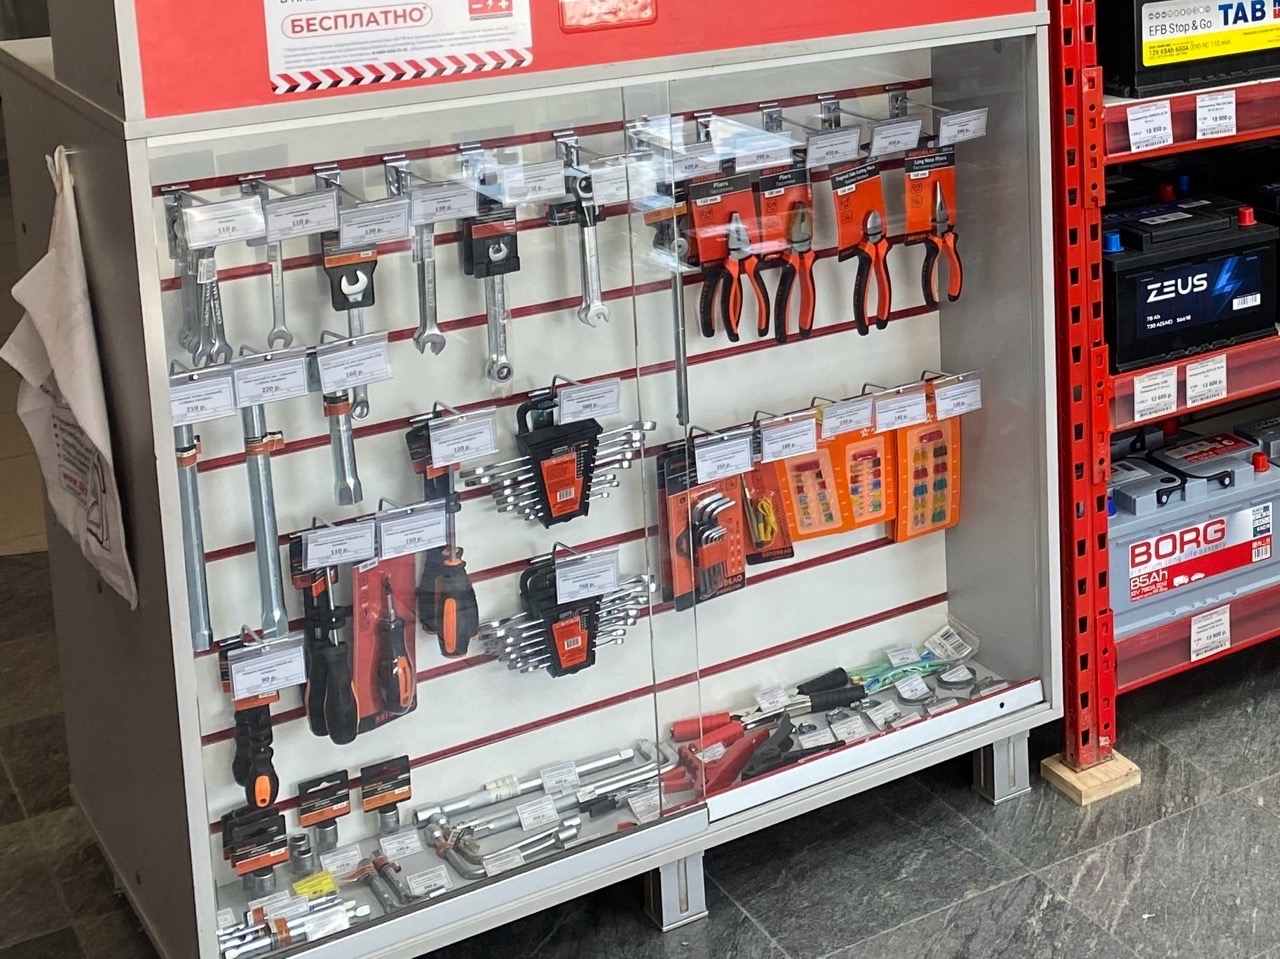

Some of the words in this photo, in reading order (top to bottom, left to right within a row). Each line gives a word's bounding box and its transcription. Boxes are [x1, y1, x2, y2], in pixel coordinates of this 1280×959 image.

[290, 6, 424, 34] БЕСПЛАТНО
[1218, 0, 1266, 26] TAB
[1149, 24, 1167, 36] EFB
[1169, 21, 1190, 36] Stop
[1192, 20, 1198, 31] &
[1200, 19, 1212, 29] Go
[713, 180, 729, 189] Pliers
[1147, 273, 1208, 303] ZEUS
[262, 385, 274, 393] 220
[1130, 518, 1226, 569] BORG
[1130, 570, 1168, 591] 85Ah
